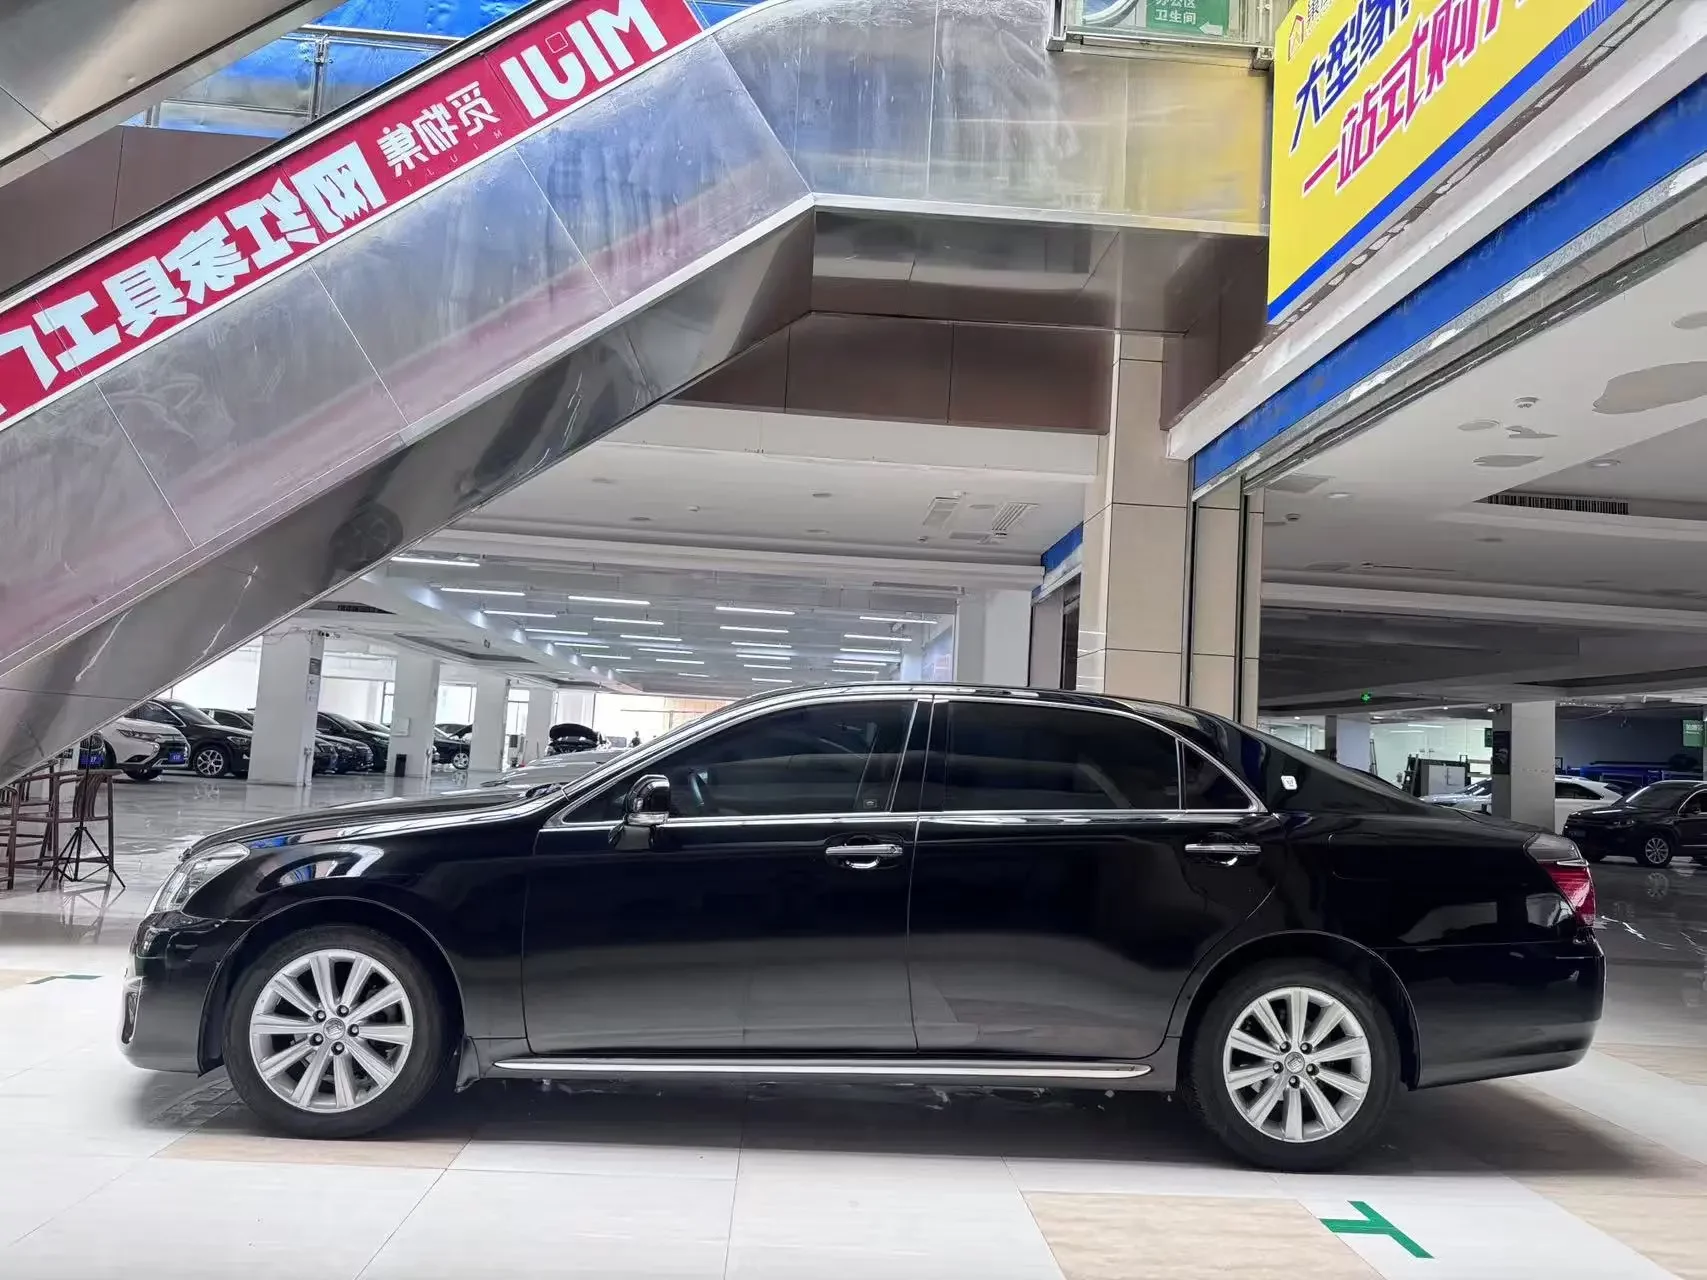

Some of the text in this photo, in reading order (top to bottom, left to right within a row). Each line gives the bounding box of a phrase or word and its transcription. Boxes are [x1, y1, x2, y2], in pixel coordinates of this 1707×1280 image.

[1155, 9, 1196, 25] 卫生间
[1290, 0, 1411, 153] 大型家
[1303, 0, 1500, 192] 一站式购
